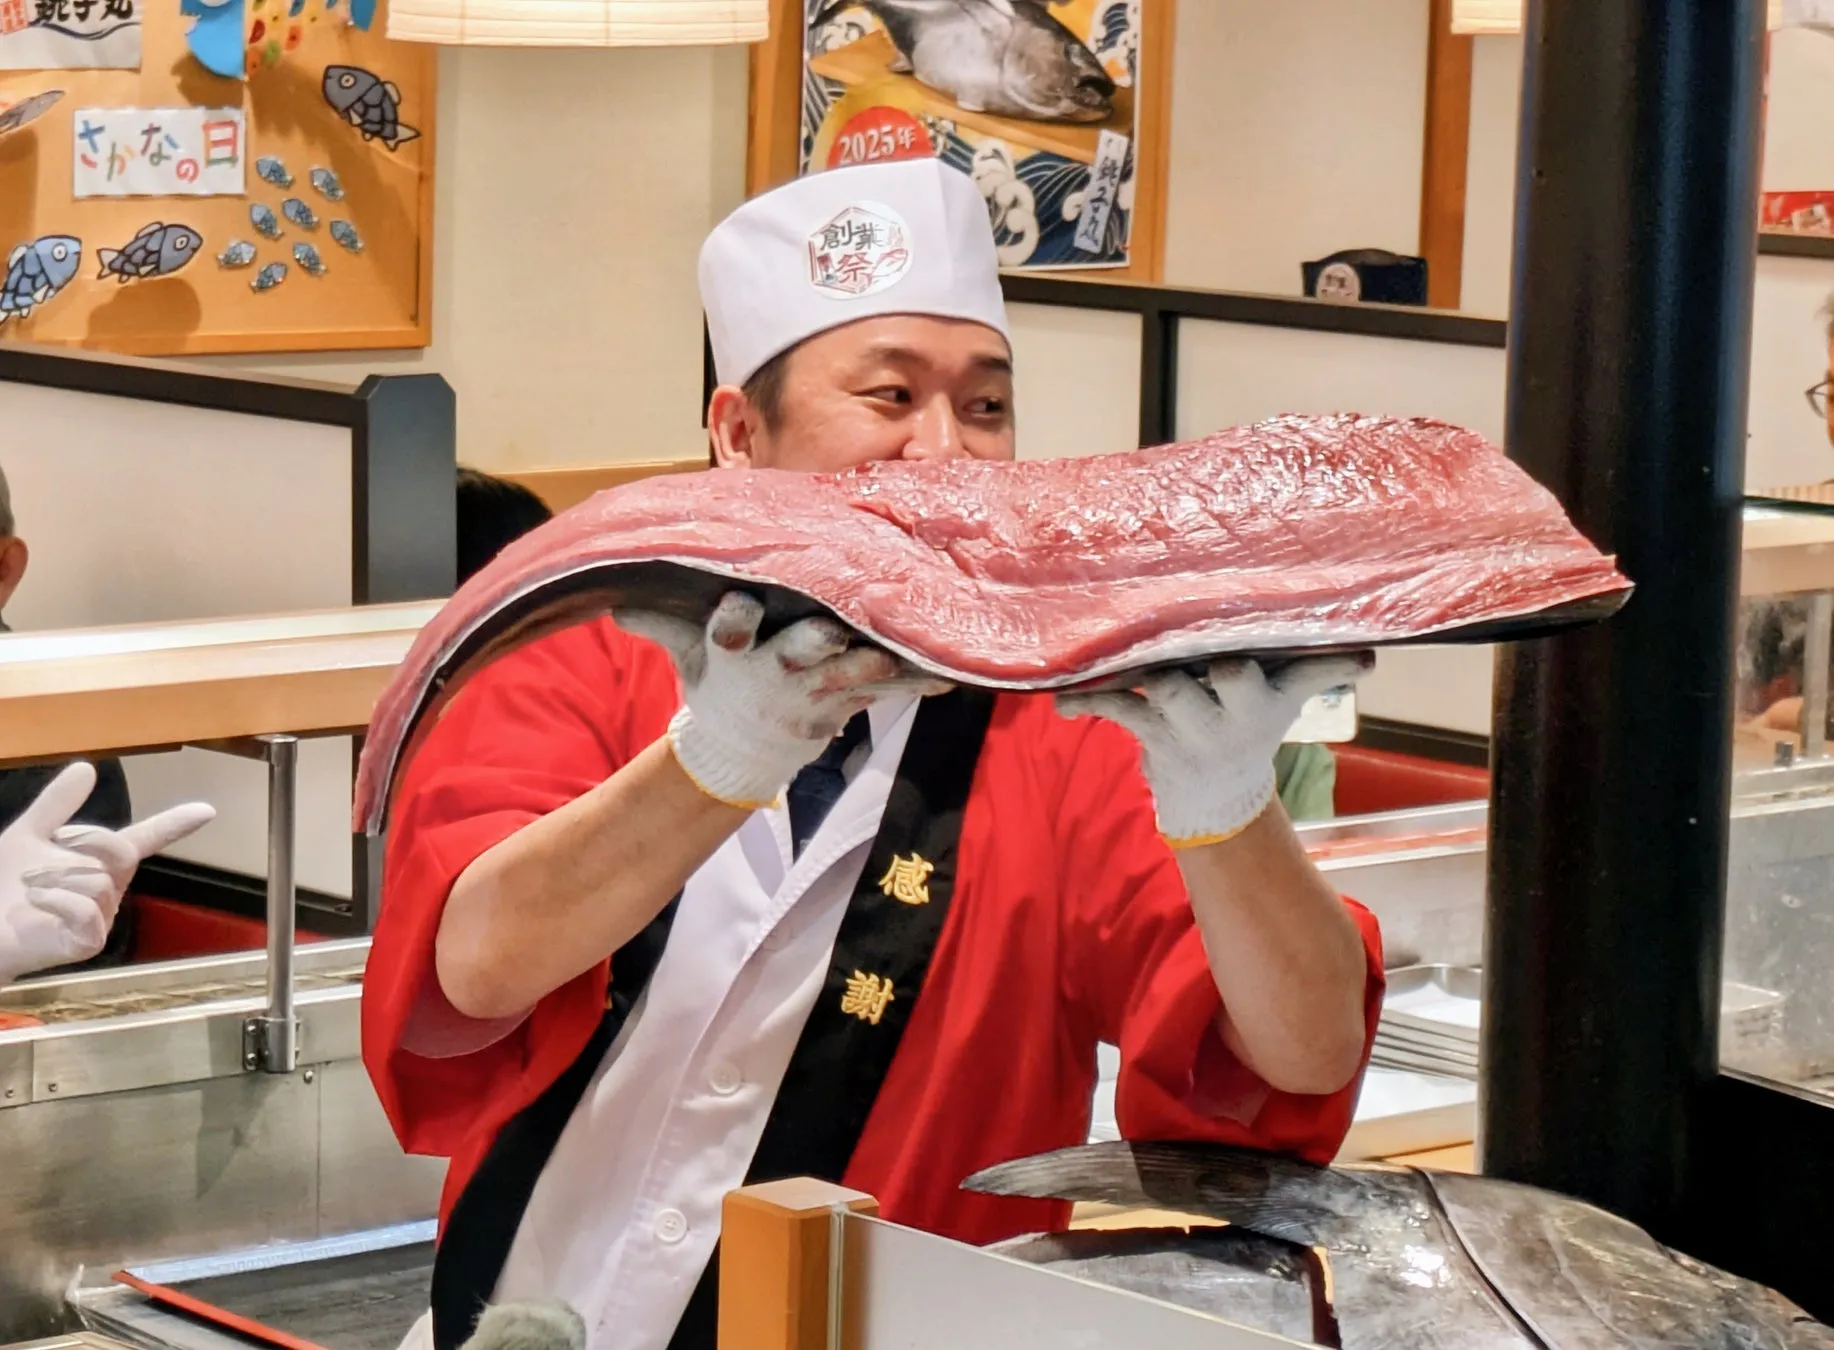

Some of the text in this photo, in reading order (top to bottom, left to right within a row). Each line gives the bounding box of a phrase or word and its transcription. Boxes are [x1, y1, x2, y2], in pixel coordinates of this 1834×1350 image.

[78, 119, 239, 184] さかなの日
[839, 124, 917, 165] 2025年
[840, 851, 935, 1026] 感謝
